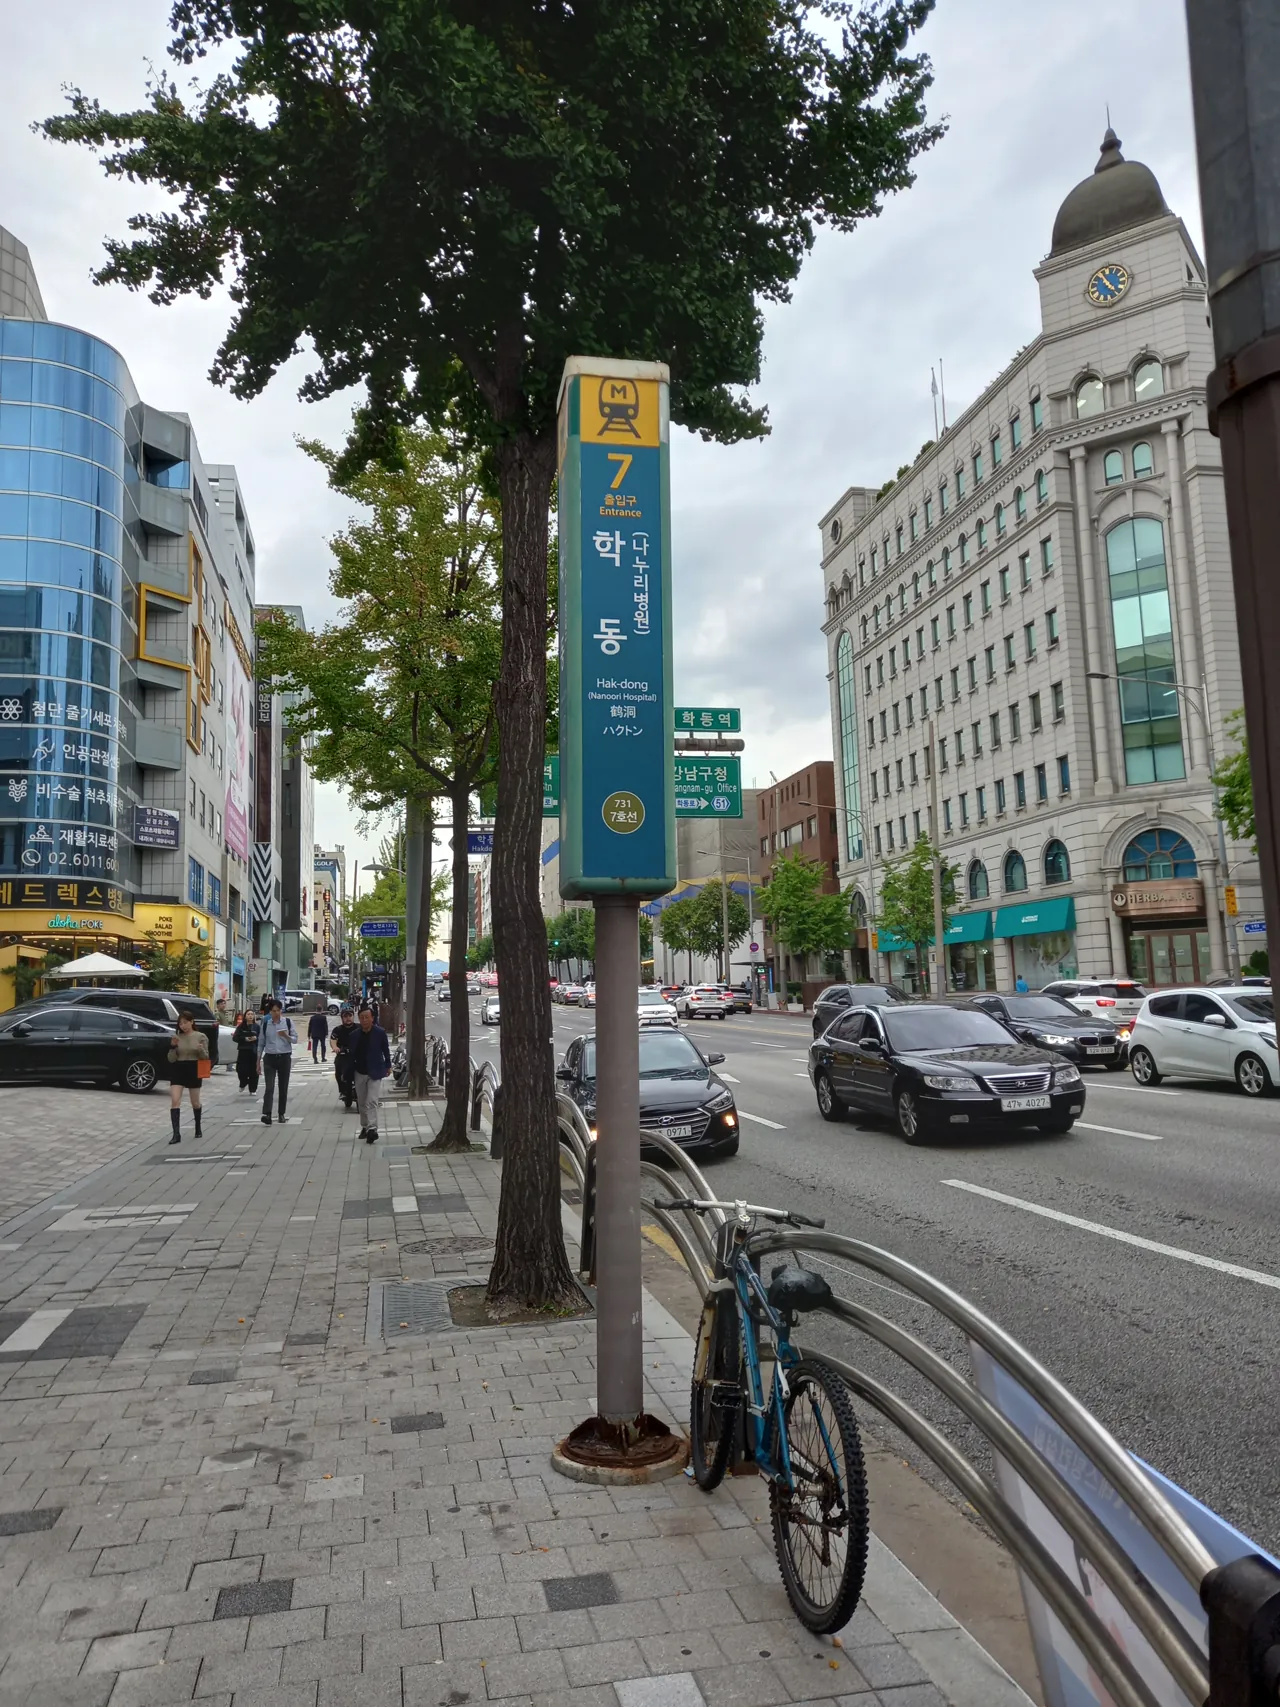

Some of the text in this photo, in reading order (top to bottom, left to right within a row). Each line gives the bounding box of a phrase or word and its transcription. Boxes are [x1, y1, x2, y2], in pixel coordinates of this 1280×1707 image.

[610, 383, 628, 399] M
[607, 453, 633, 489] 7
[603, 493, 638, 507] 출입구
[599, 506, 643, 517] Entrance
[631, 531, 651, 635] (나누리병원)
[596, 677, 649, 692] Hak-dong
[588, 691, 657, 702] (Nanoori Hospital)
[32, 700, 63, 718] 첨단
[610, 705, 637, 719] 鹤洞
[602, 724, 644, 737] ハクトン
[673, 765, 728, 782] 강남구청
[37, 783, 82, 801] 비수술
[674, 782, 737, 795] angnam-gu Office
[614, 799, 632, 808] 731
[715, 798, 726, 809] 51
[609, 810, 638, 824] 7호선
[48, 914, 104, 930] aloha POKE
[1025, 1097, 1046, 1108] 4027
[666, 1127, 687, 1137] 0971
